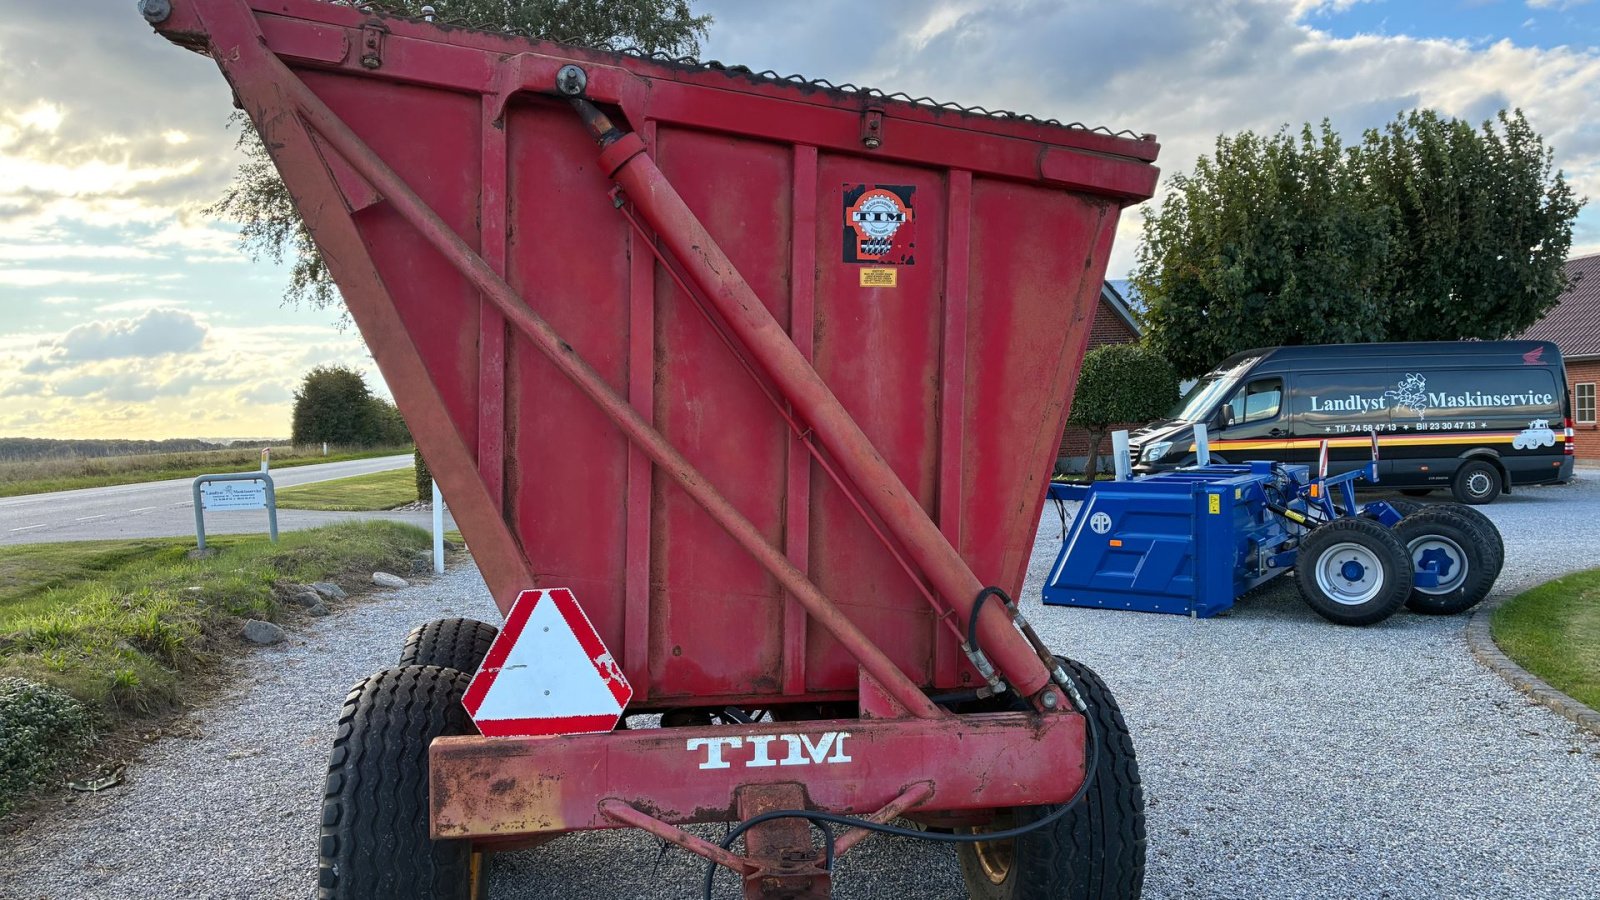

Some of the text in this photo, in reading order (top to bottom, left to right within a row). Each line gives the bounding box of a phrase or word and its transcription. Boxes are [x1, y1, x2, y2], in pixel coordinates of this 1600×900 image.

[855, 212, 903, 222] TIM
[1310, 390, 1552, 414] Landlyst Maskinservice
[1351, 424, 1361, 432] 74
[1362, 424, 1373, 432] 58
[1375, 424, 1385, 432] 47
[1388, 423, 1397, 431] 13
[1416, 422, 1428, 431] Bil
[1429, 422, 1440, 430] 23
[1441, 422, 1452, 430] 30
[1453, 422, 1464, 430] 47
[1466, 421, 1476, 429] 13
[686, 732, 852, 770] TIM
